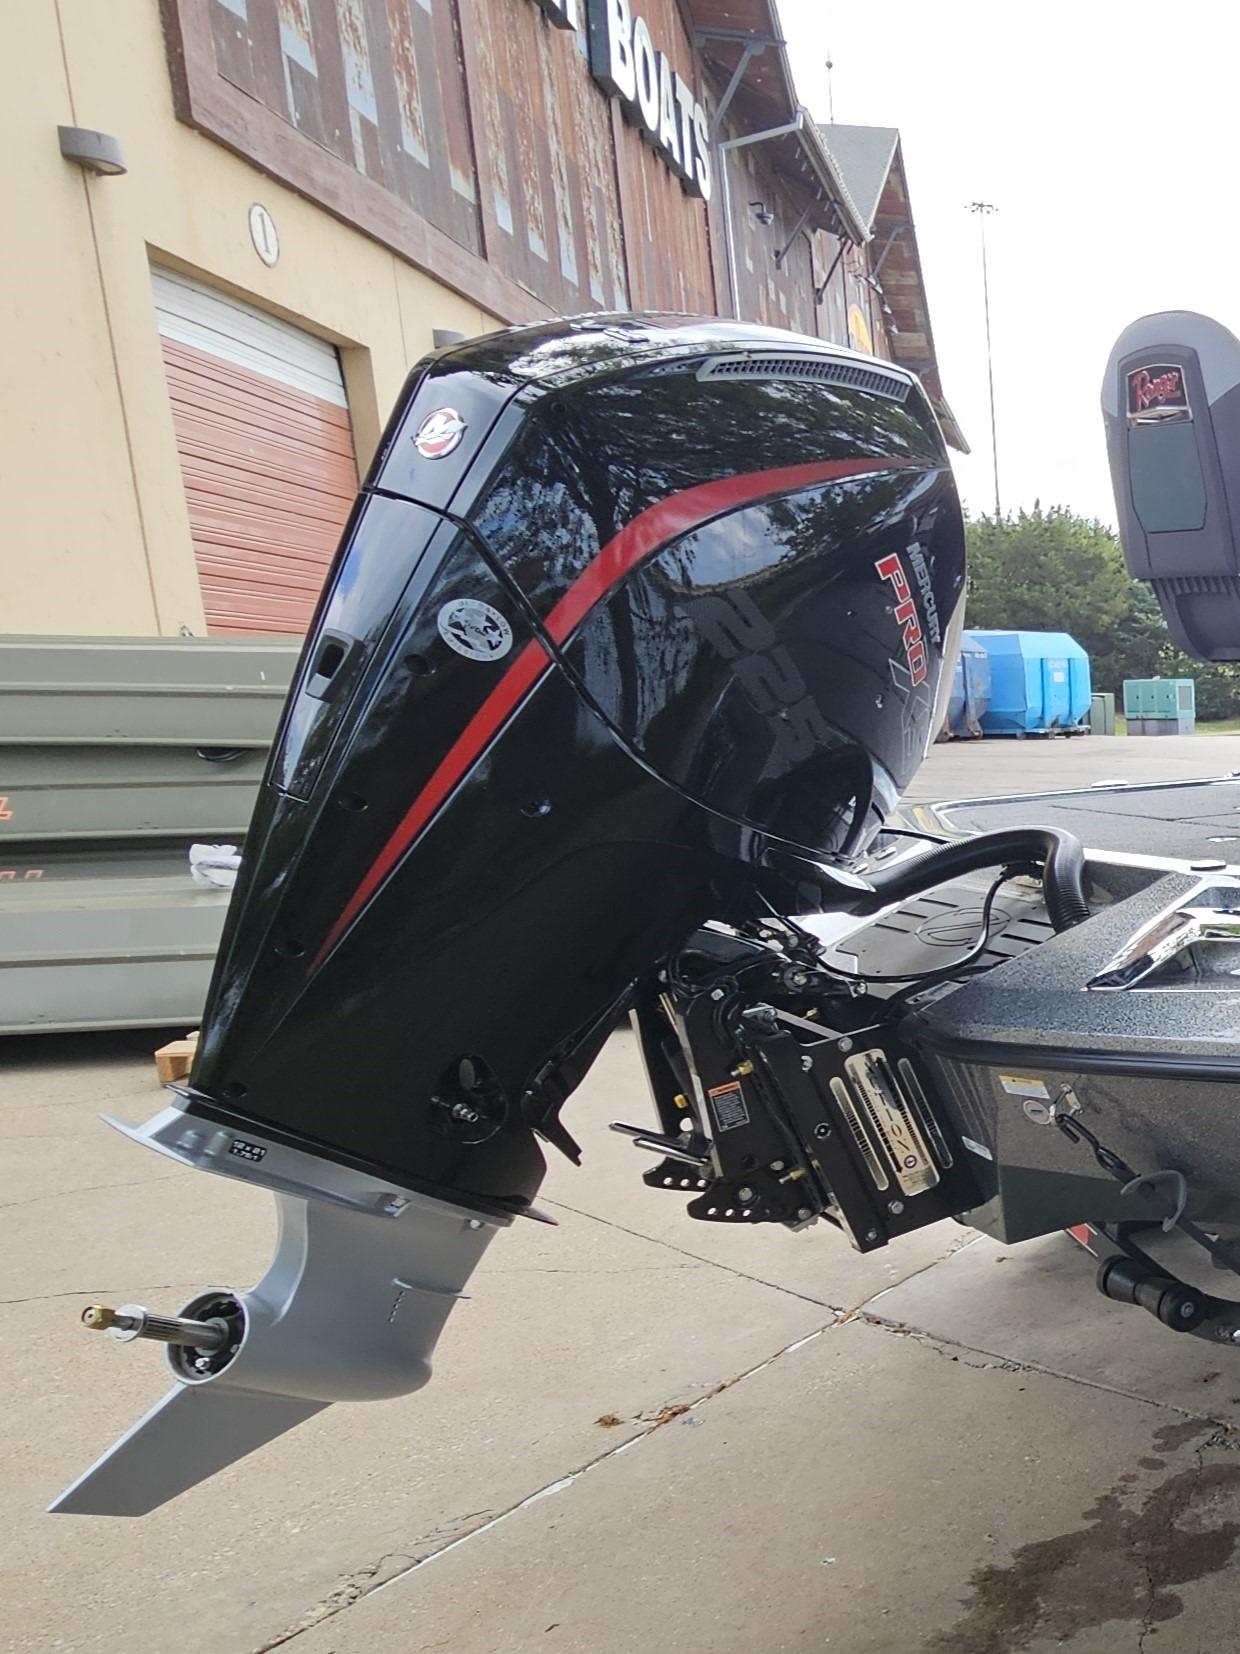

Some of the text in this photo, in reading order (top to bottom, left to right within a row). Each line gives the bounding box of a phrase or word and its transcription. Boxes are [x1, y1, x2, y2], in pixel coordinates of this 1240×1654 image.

[607, 0, 711, 201] BOATS
[1131, 370, 1181, 411] Ranger
[874, 552, 927, 687] PRO
[906, 542, 941, 643] MERCURY
